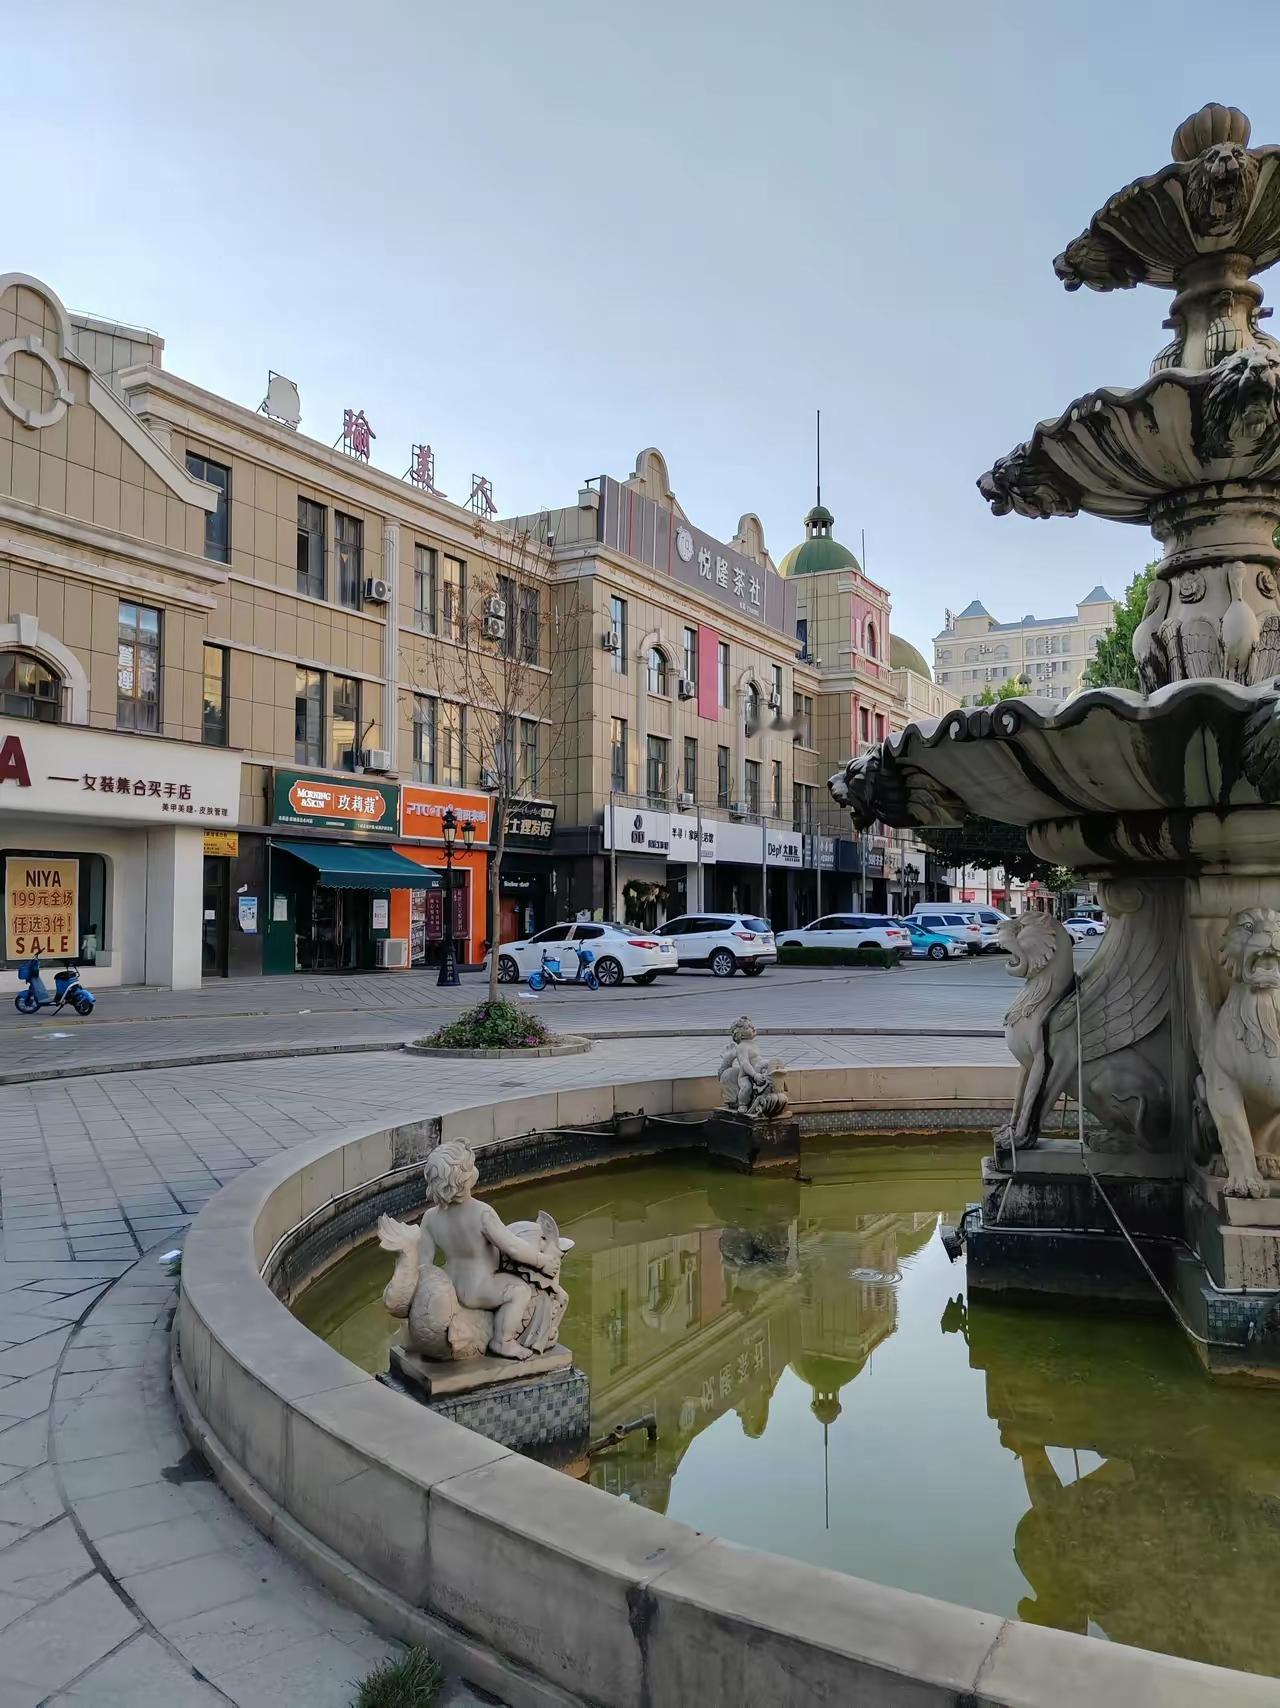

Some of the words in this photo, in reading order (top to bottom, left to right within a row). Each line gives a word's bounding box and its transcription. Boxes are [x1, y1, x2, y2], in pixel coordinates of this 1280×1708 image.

[697, 546, 761, 606] 悦隆茶社
[338, 794, 375, 814] 玫莉蔻
[689, 829, 715, 843] 家居活馆
[25, 869, 62, 888] NIYA
[12, 890, 73, 909] 199元全场
[13, 914, 72, 935] 任选3件!
[15, 935, 69, 954] SALE
